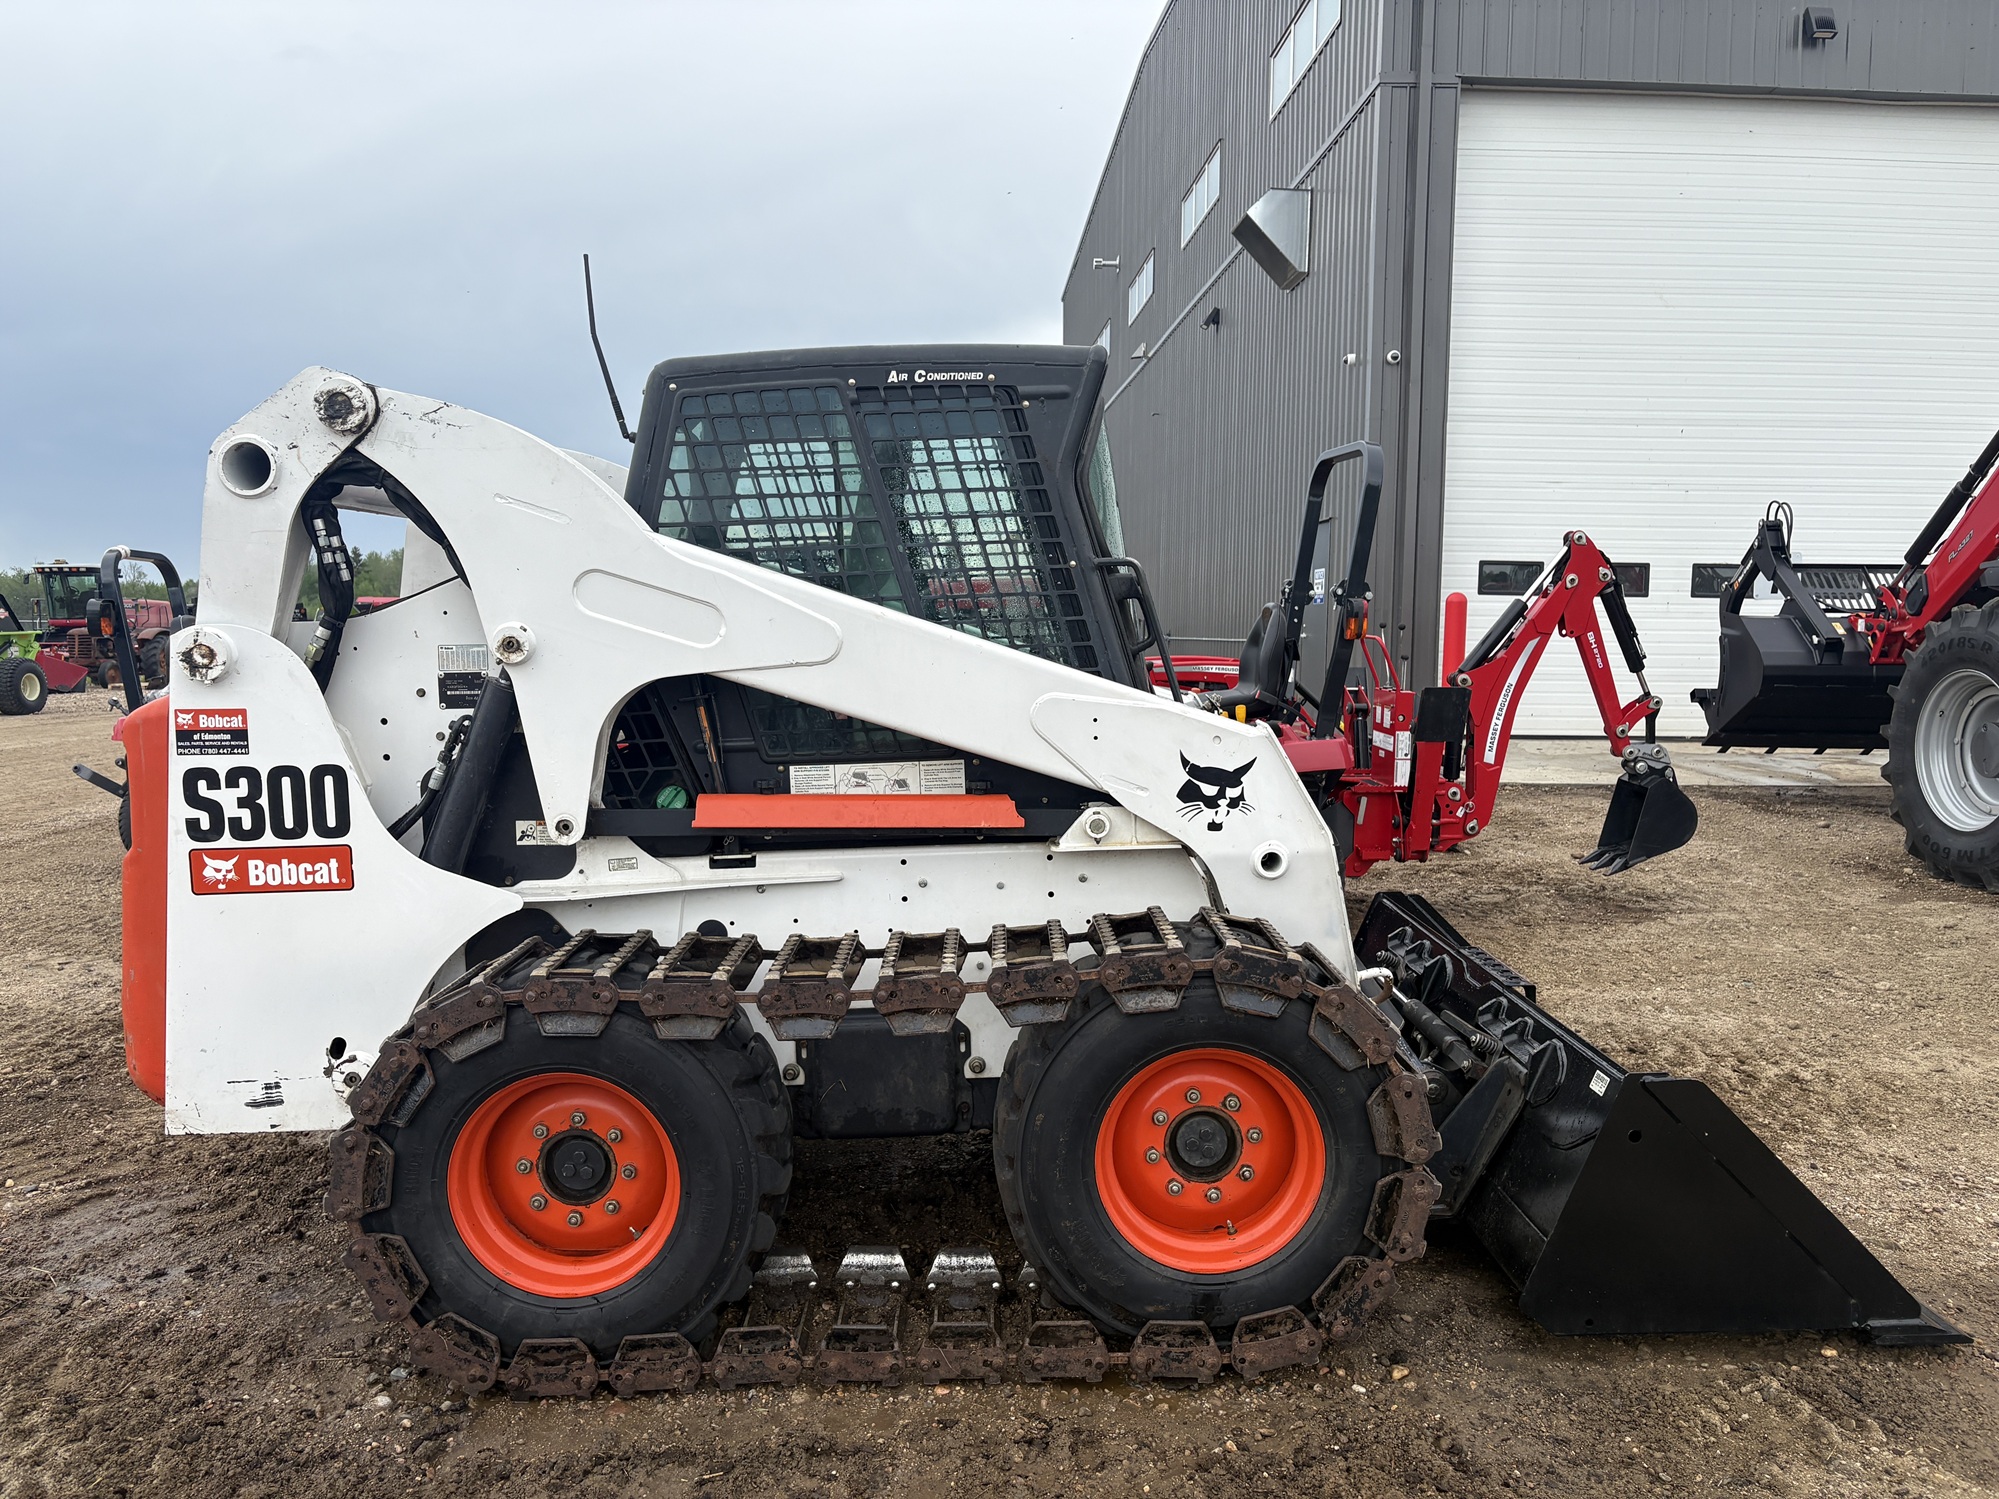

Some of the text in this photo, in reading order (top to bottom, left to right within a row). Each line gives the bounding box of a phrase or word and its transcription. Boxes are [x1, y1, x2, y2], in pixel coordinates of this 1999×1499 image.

[887, 369, 983, 383] AIR CONDITIONED
[1587, 631, 1603, 669] BH 2720
[198, 714, 243, 728] Bobcat
[1488, 682, 1514, 753] MASSEY FERGUSON
[182, 764, 351, 843] S300
[247, 858, 339, 886] Bobcat
